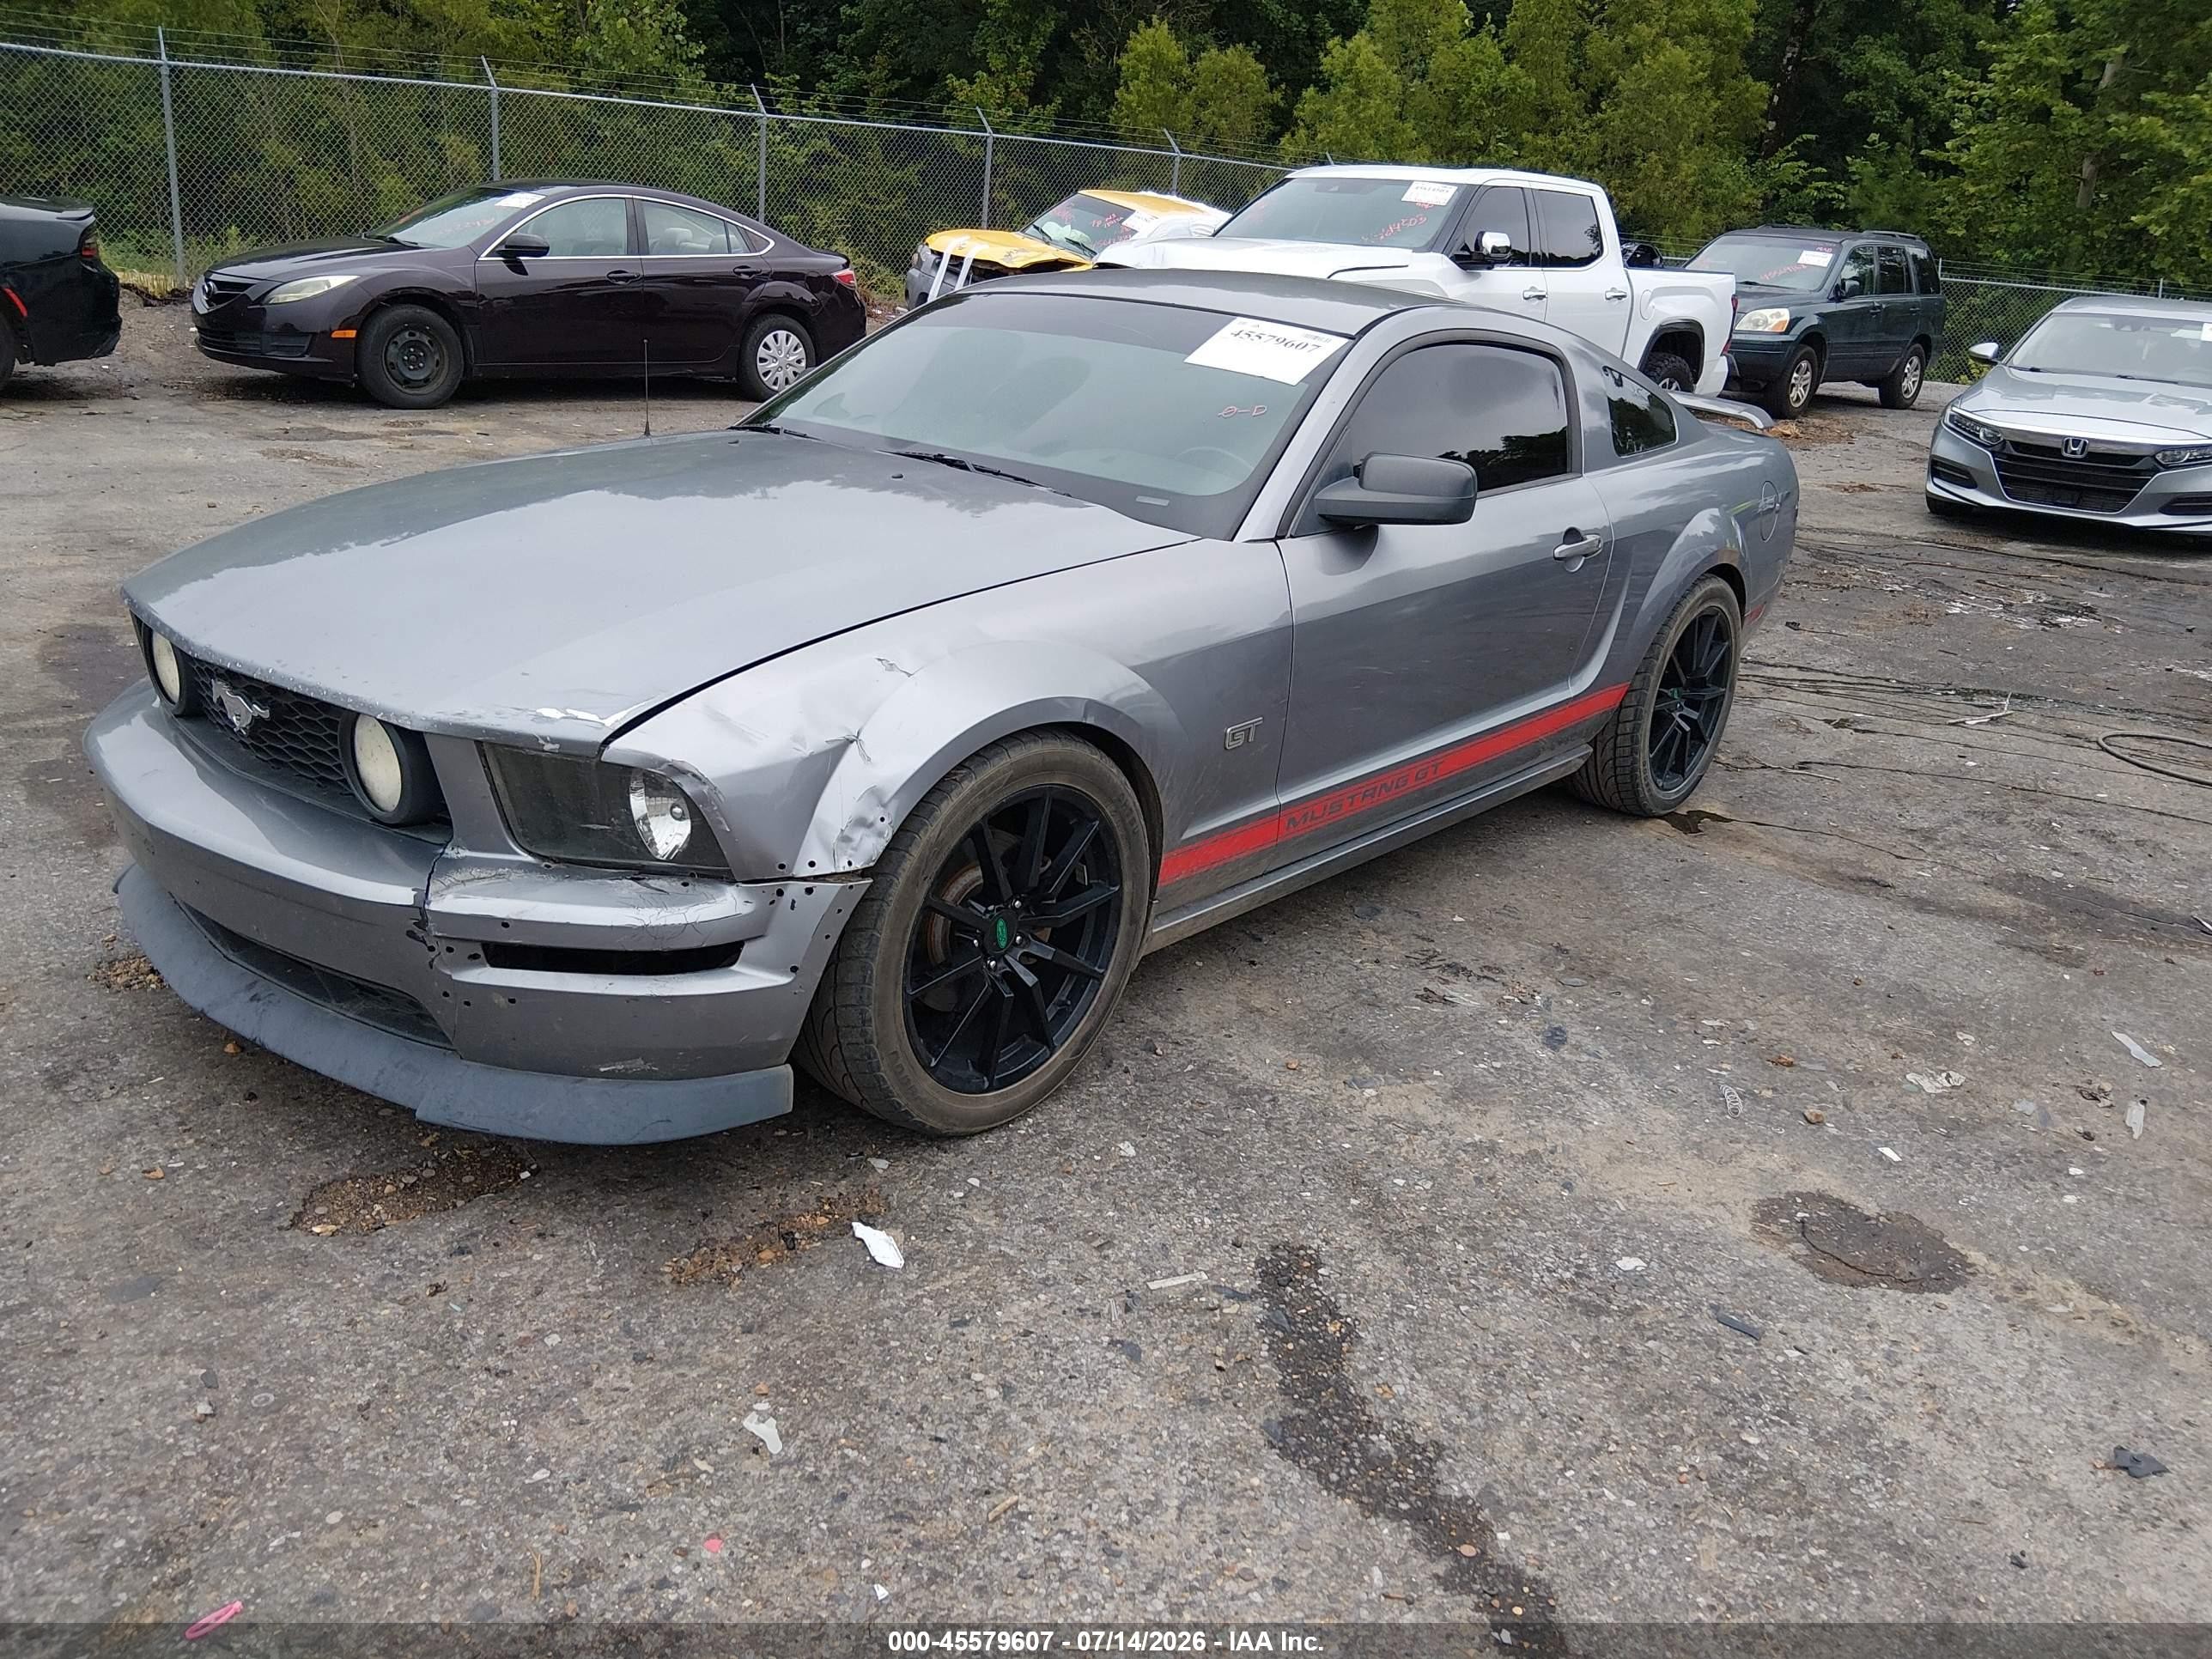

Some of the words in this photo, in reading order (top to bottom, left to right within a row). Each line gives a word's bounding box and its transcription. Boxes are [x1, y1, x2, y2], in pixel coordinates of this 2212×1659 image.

[1230, 329, 1322, 353] 45579607
[1224, 716, 1263, 750] GT
[1285, 776, 1409, 830] MUSTANG
[1414, 761, 1443, 782] GT
